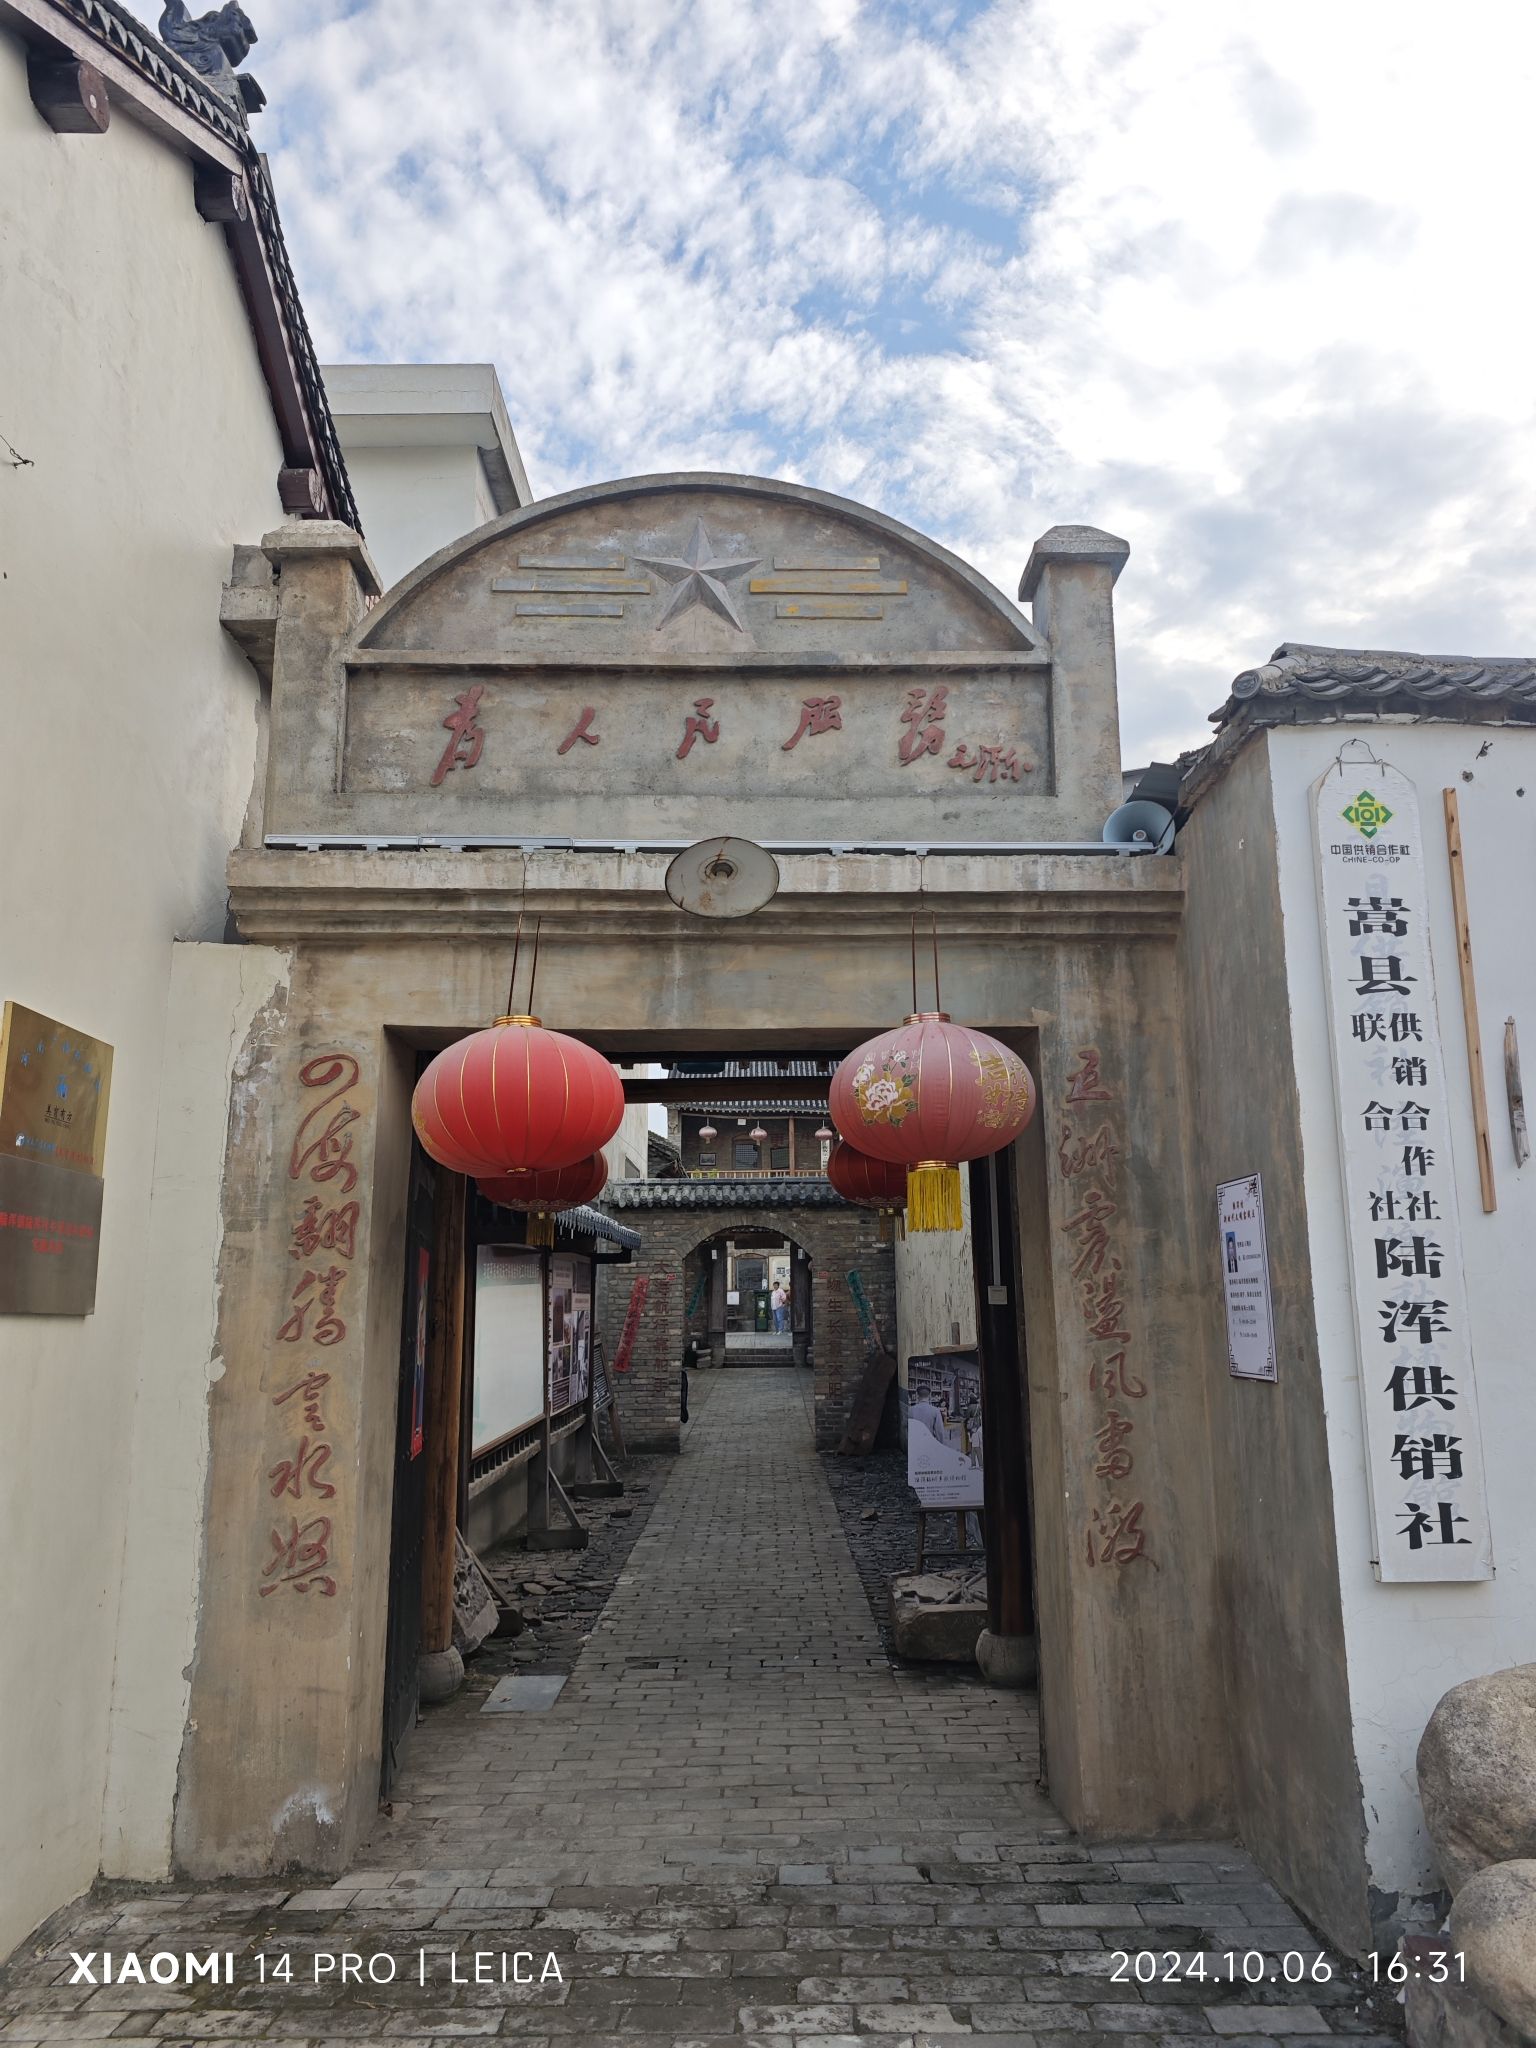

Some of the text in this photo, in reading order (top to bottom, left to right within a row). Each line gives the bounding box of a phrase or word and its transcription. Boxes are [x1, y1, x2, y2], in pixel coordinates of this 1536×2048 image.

[1330, 844, 1411, 857] 中国供销合作社
[1343, 896, 1418, 996] 嵩县
[1373, 1235, 1473, 1550] 陆浑供销社
